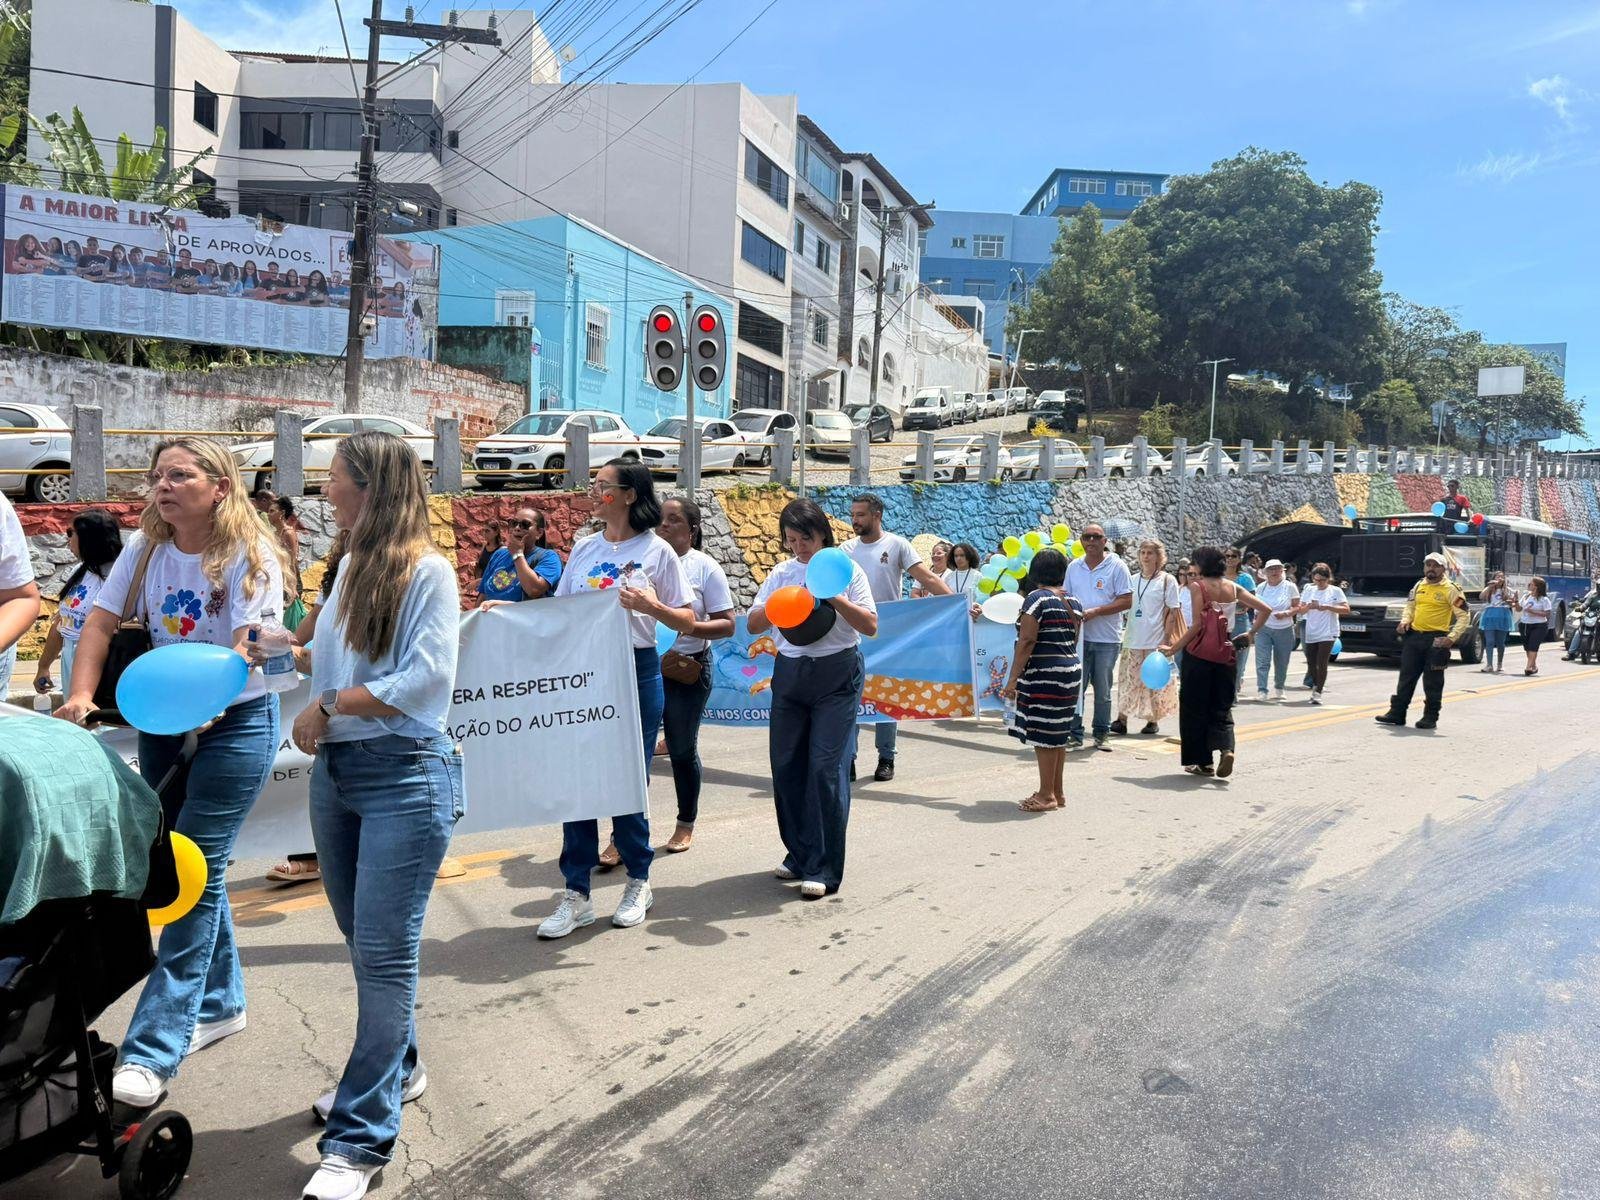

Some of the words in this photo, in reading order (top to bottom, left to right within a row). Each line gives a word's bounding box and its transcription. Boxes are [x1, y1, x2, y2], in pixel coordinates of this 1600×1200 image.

[19, 194, 35, 212] A
[44, 197, 119, 223] MAIOR
[128, 208, 188, 233] LIA
[177, 234, 201, 248] DE
[207, 238, 326, 265] APROVADOS...
[451, 688, 486, 705] ERA
[492, 671, 595, 700] RESPEITO!"
[446, 718, 491, 743] AÇÃO
[496, 717, 522, 735] DO
[528, 704, 621, 730] AUTISMO.
[716, 708, 741, 721] NOS
[742, 708, 771, 721] CON
[273, 767, 300, 782] DE
